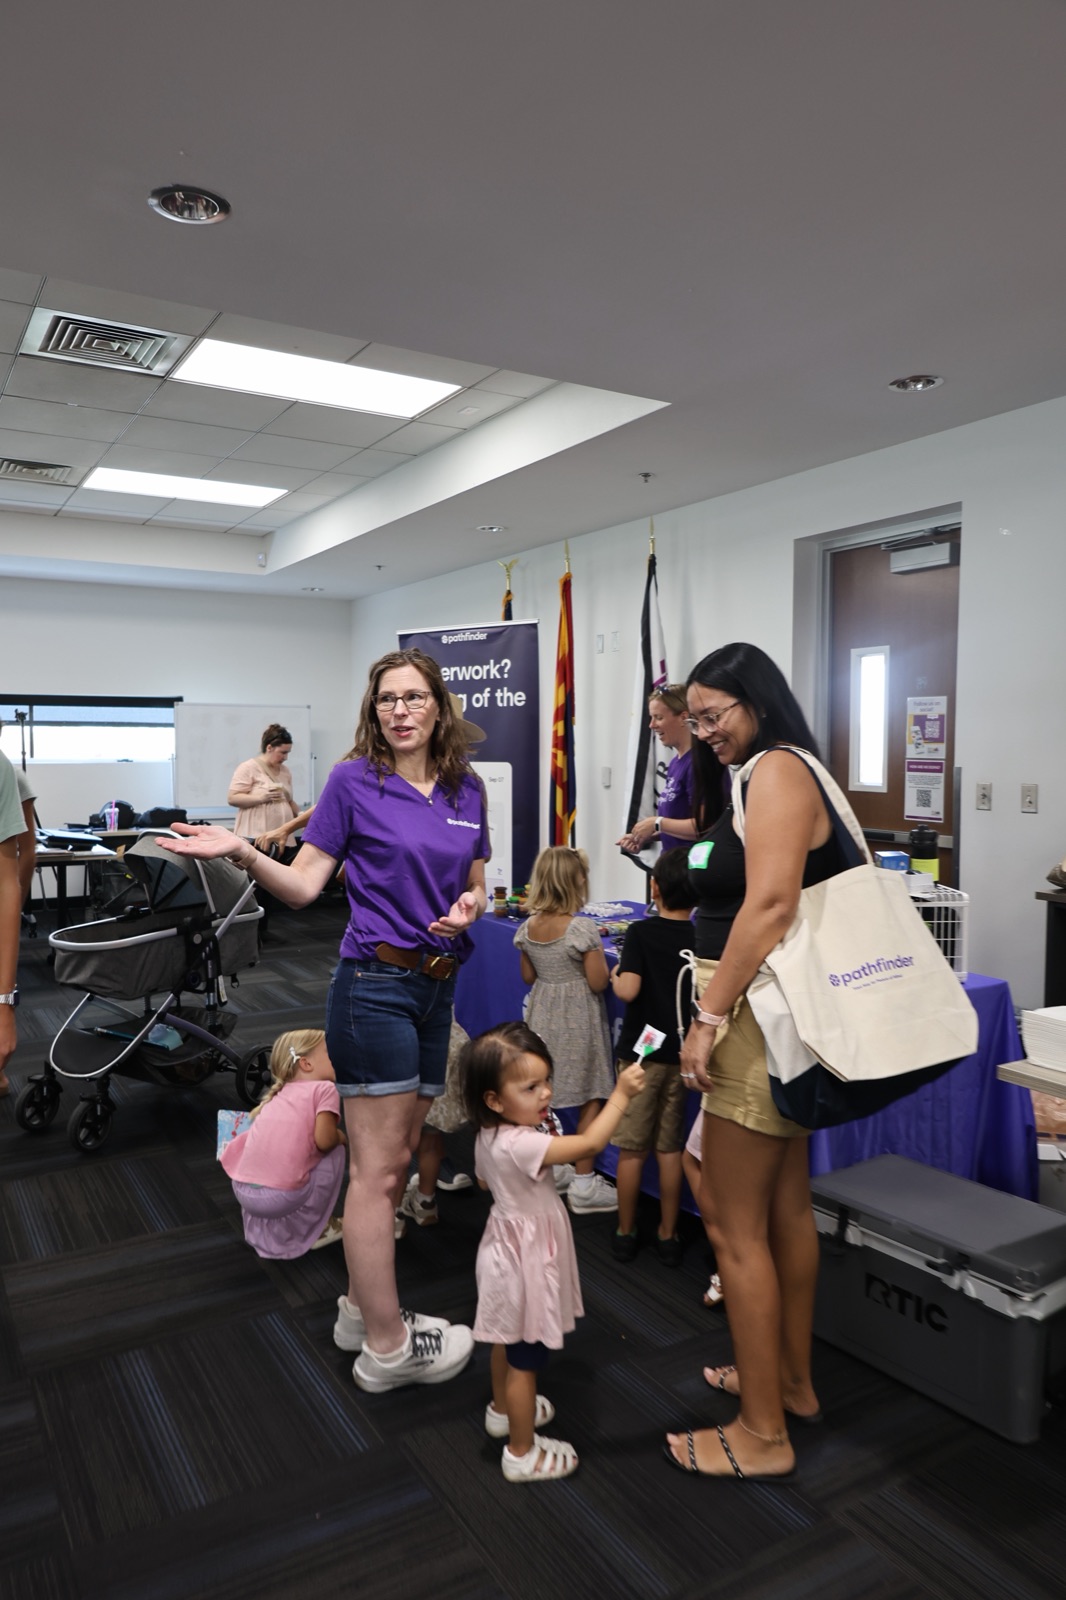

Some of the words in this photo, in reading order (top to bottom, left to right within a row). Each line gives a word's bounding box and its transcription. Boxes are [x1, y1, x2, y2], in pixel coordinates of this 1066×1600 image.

[448, 632, 487, 644] pathfinder
[441, 659, 511, 681] erwork?
[471, 687, 491, 708] of
[495, 687, 526, 707] the
[841, 954, 914, 987] pathfinder
[865, 1271, 949, 1334] RTIC
